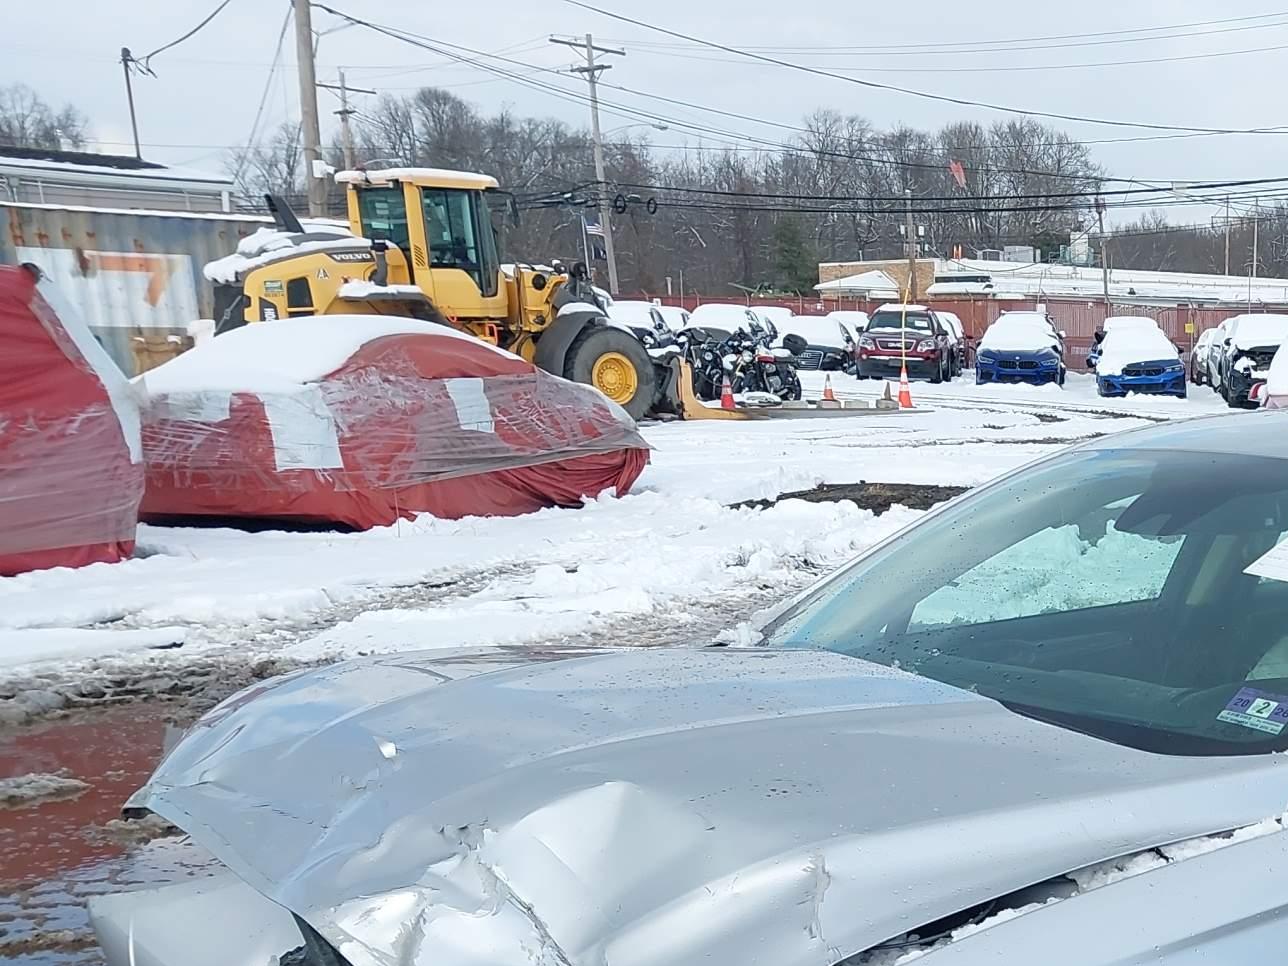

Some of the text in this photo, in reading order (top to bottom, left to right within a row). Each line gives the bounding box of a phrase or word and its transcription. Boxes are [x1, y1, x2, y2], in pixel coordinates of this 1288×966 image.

[331, 253, 371, 261] VOLVO
[1233, 697, 1250, 708] 20
[1255, 701, 1271, 715] 2
